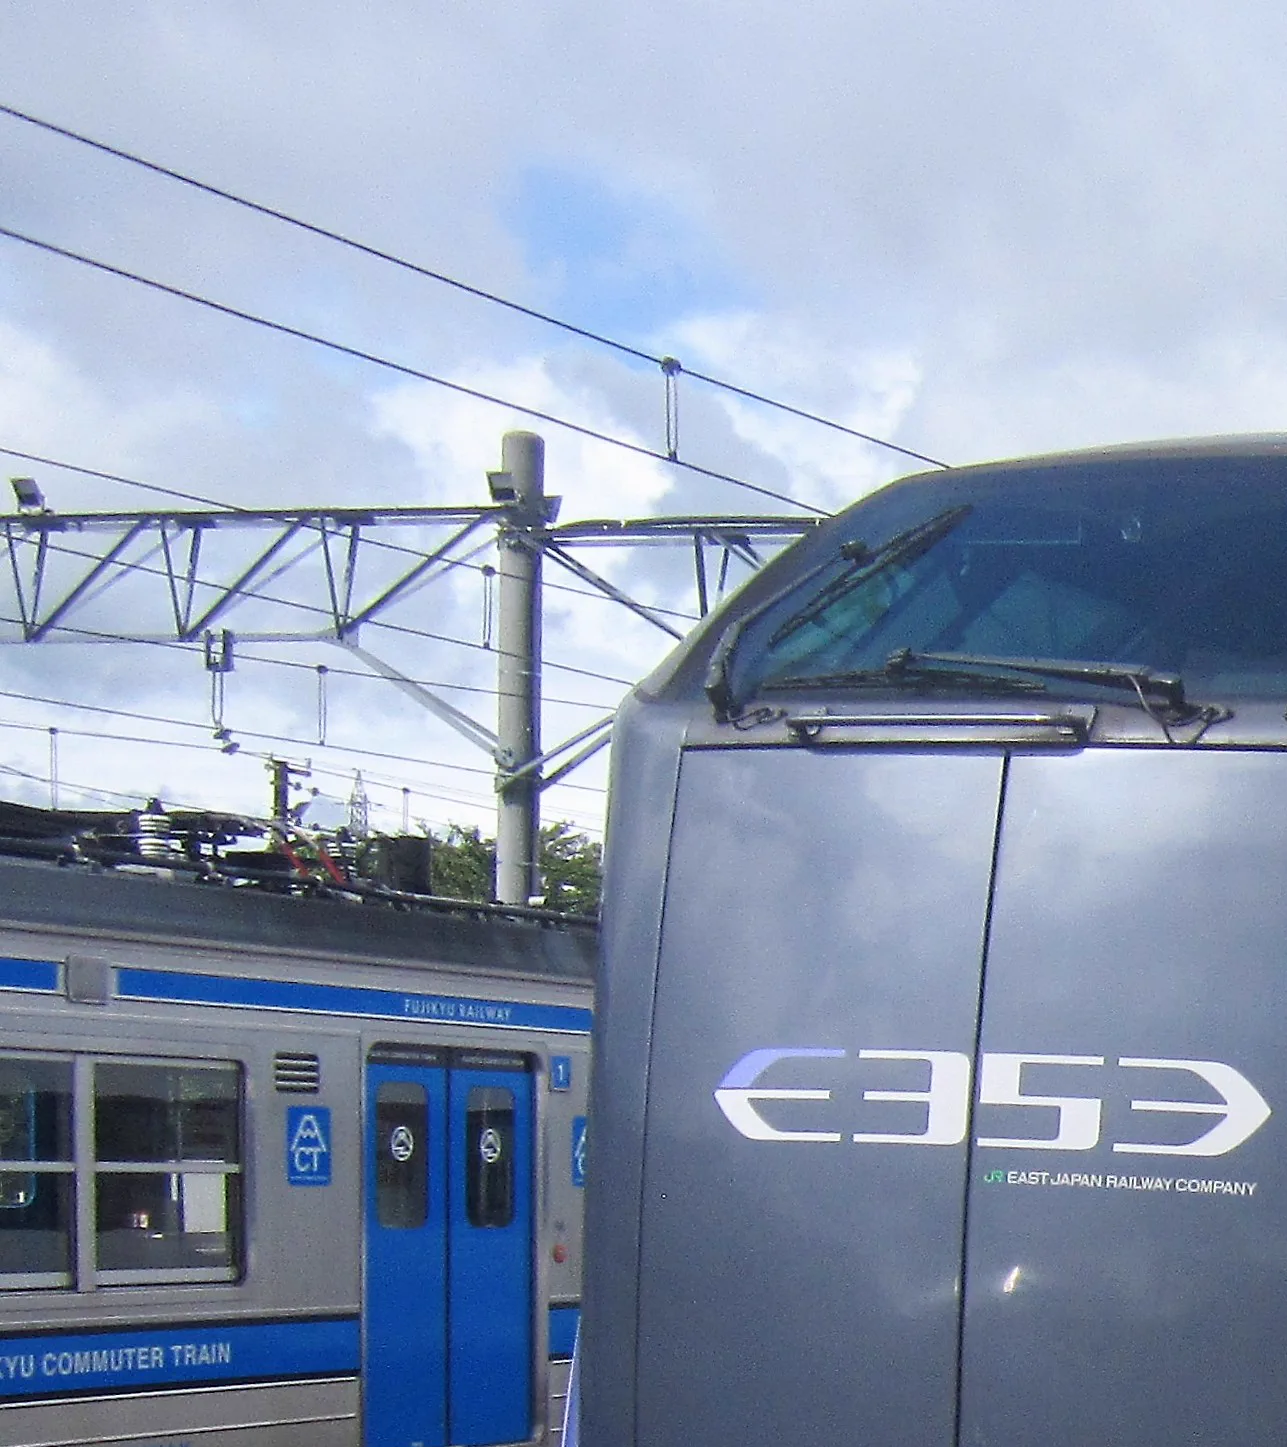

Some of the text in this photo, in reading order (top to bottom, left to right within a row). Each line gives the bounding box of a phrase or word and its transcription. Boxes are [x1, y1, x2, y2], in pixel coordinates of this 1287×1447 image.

[405, 999, 512, 1020] FUJIKYU RAILWAY
[557, 1063, 564, 1082] 1
[713, 1047, 1272, 1157] E353
[983, 1169, 1258, 1196] JR EAST JAPAN RAILWAY COMPANY
[42, 1347, 164, 1376] COMMUTER
[170, 1342, 232, 1367] TRAIN
